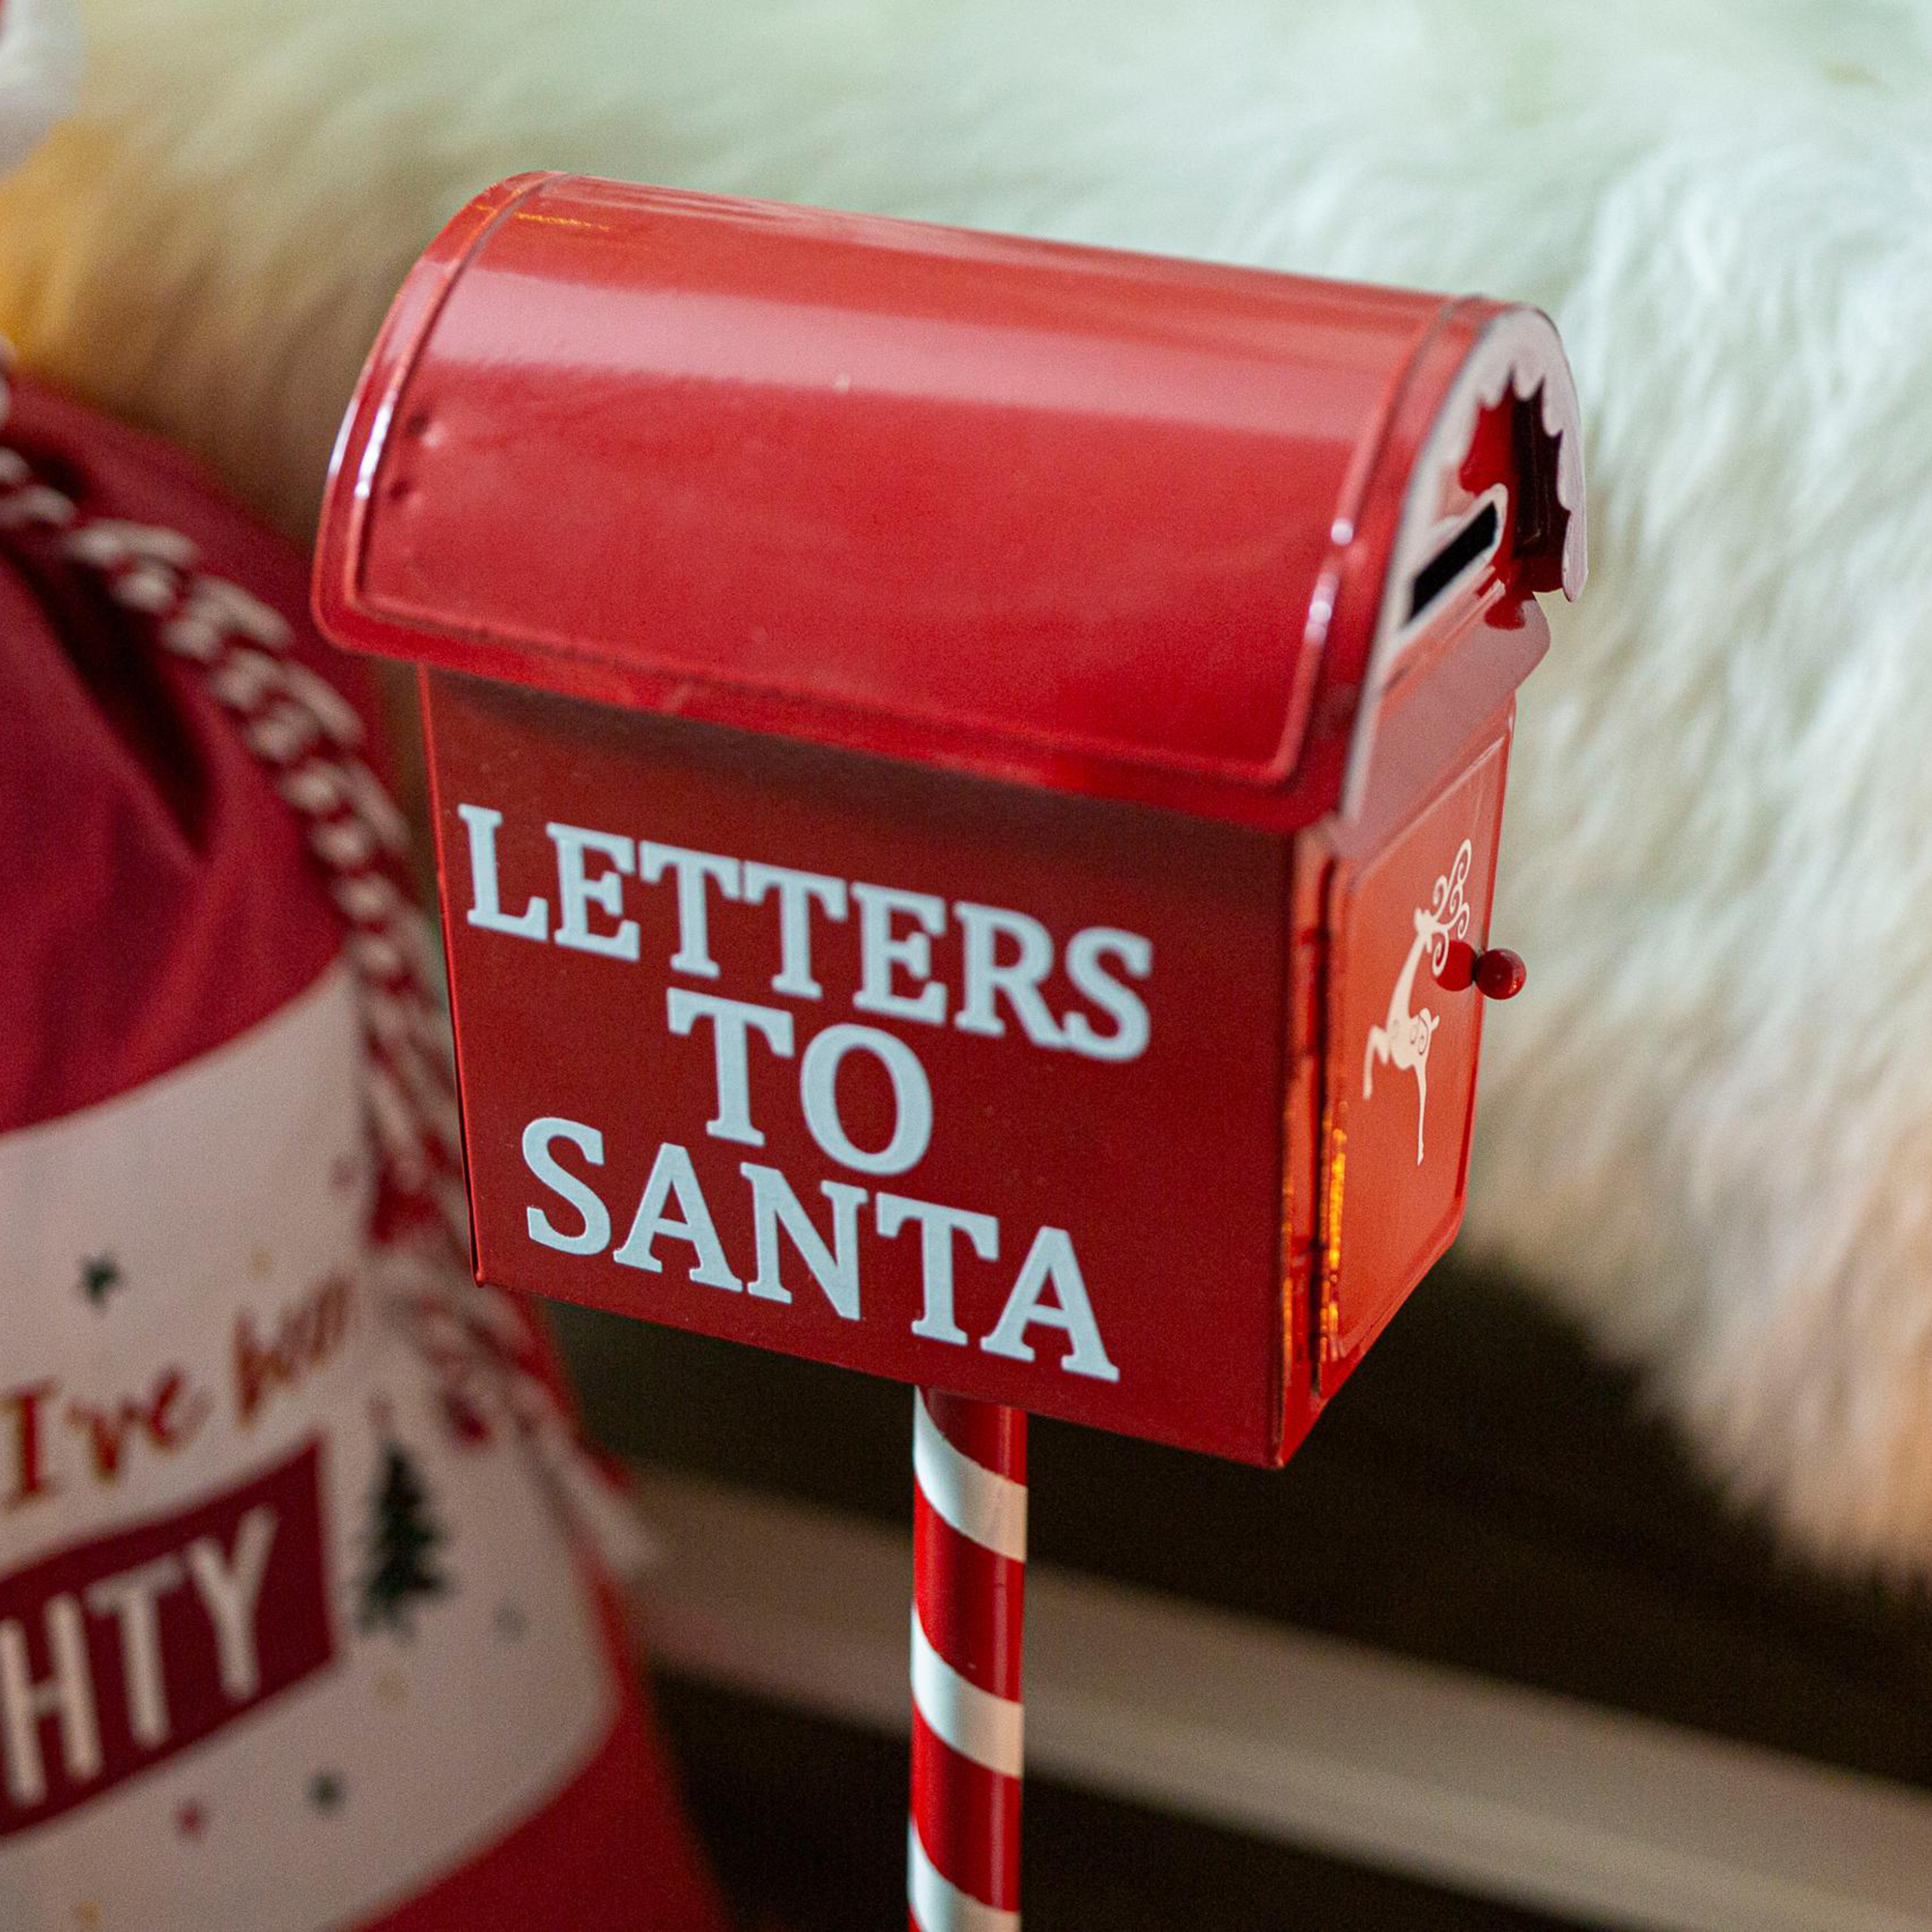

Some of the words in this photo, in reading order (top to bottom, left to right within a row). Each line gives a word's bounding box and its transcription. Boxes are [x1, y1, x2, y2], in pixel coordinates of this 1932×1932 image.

[456, 802, 1153, 1064] LETTERS
[667, 986, 933, 1176] TO
[521, 1115, 1121, 1383] SANTA
